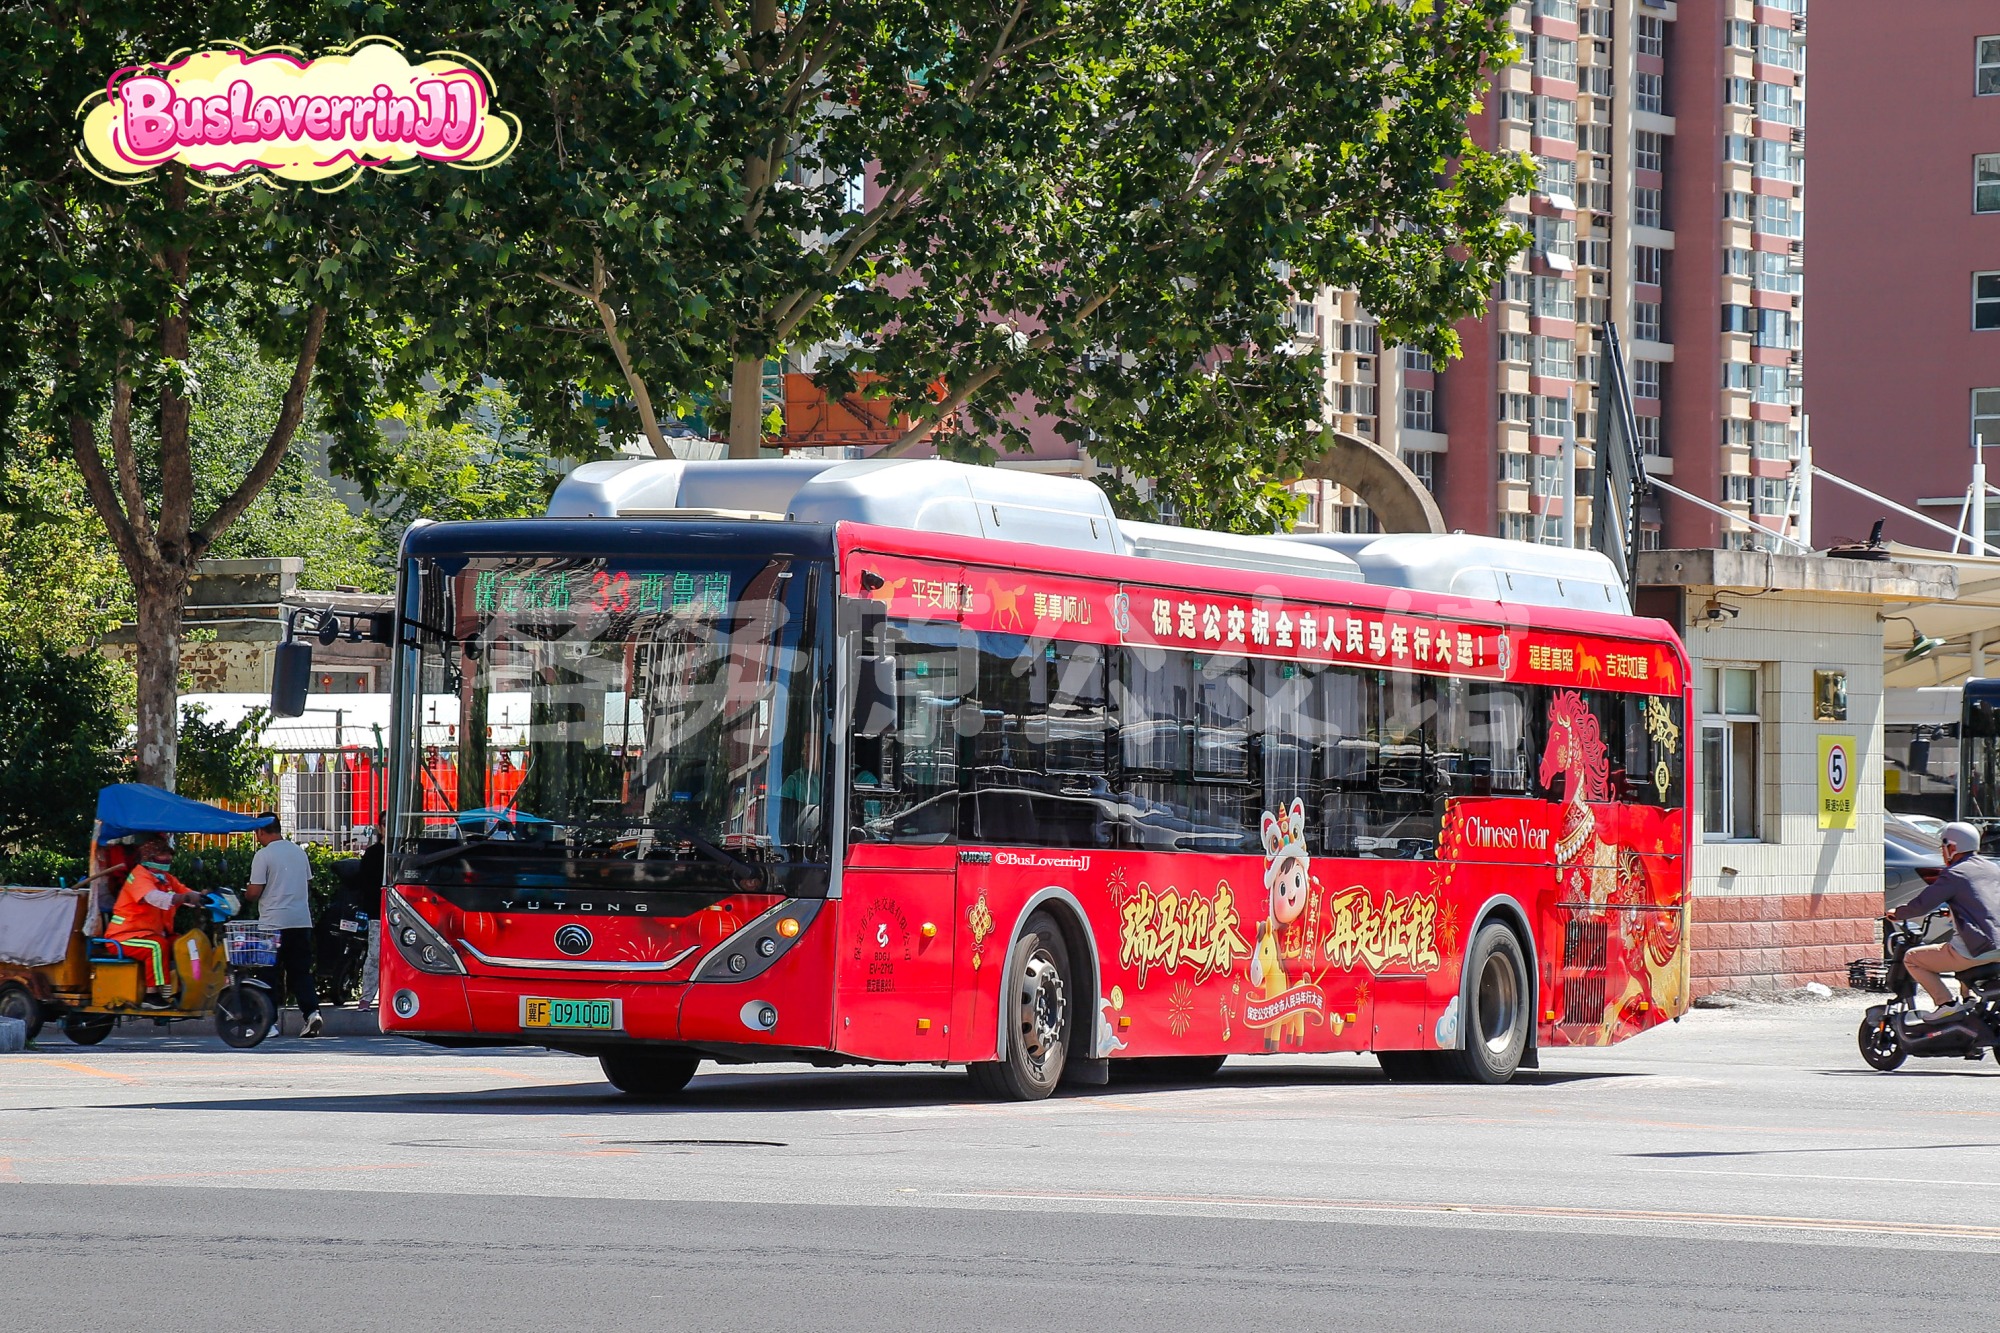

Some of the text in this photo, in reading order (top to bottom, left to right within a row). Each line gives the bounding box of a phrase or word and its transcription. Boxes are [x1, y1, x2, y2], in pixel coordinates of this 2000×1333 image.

[473, 571, 729, 614] 保定东站 33 西鲁岗
[1033, 592, 1092, 626] 事事顺心
[1529, 640, 1574, 673] 福星高照
[1606, 653, 1648, 680] 吉祥如意
[1832, 753, 1843, 786] 5
[1465, 816, 1550, 850] Chinese Year
[502, 900, 649, 912] YUTONG
[1120, 882, 1252, 988] 瑞马迎春
[1326, 885, 1441, 972] 再起征程
[874, 951, 891, 961] BDGJ
